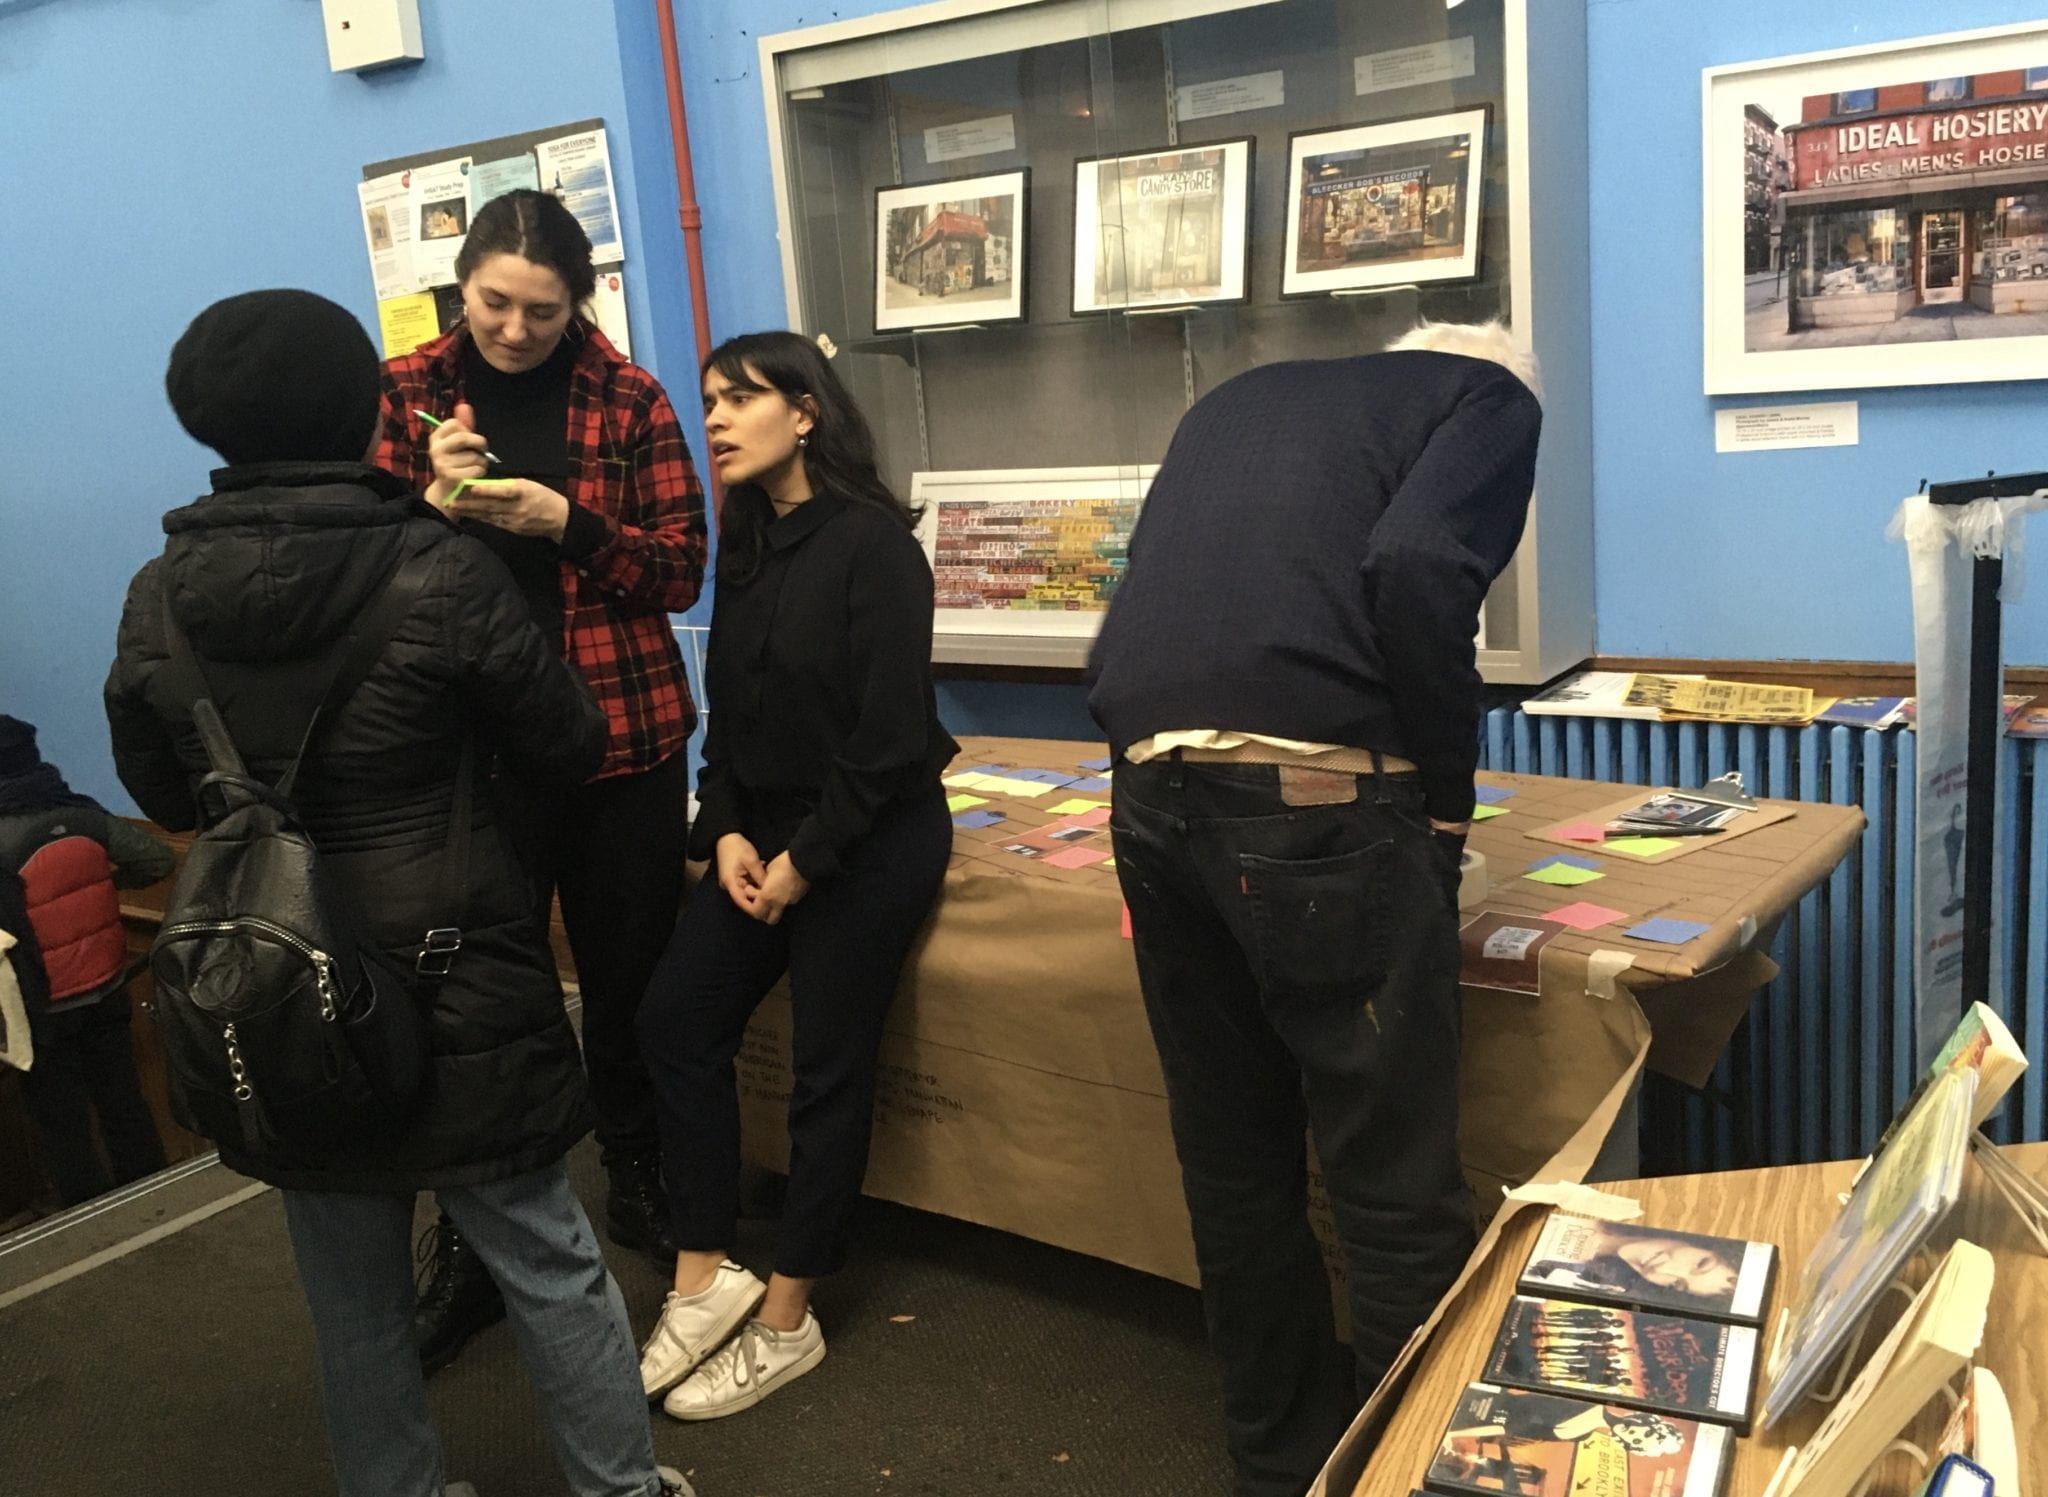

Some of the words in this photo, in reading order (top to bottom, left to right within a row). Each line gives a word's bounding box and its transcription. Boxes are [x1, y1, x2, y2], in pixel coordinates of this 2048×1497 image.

[1838, 121, 1920, 154] IDEAL
[1933, 105, 2048, 142] HOSIERY
[1814, 162, 1882, 188] LADIES
[1899, 152, 1965, 176] MEN'S
[1978, 143, 2047, 166] HOSIE
[1140, 178, 1172, 197] CANDY
[1174, 170, 1212, 193] STORE
[1311, 181, 1354, 195] BLEECKER
[1356, 176, 1382, 188] BOB'S
[1384, 169, 1425, 183] RECORDS
[1029, 499, 1076, 508] BAKERY
[1717, 1326, 1729, 1357] ULTIMATE
[1599, 1436, 1611, 1448] TO
[1613, 1447, 1625, 1472] LAST
